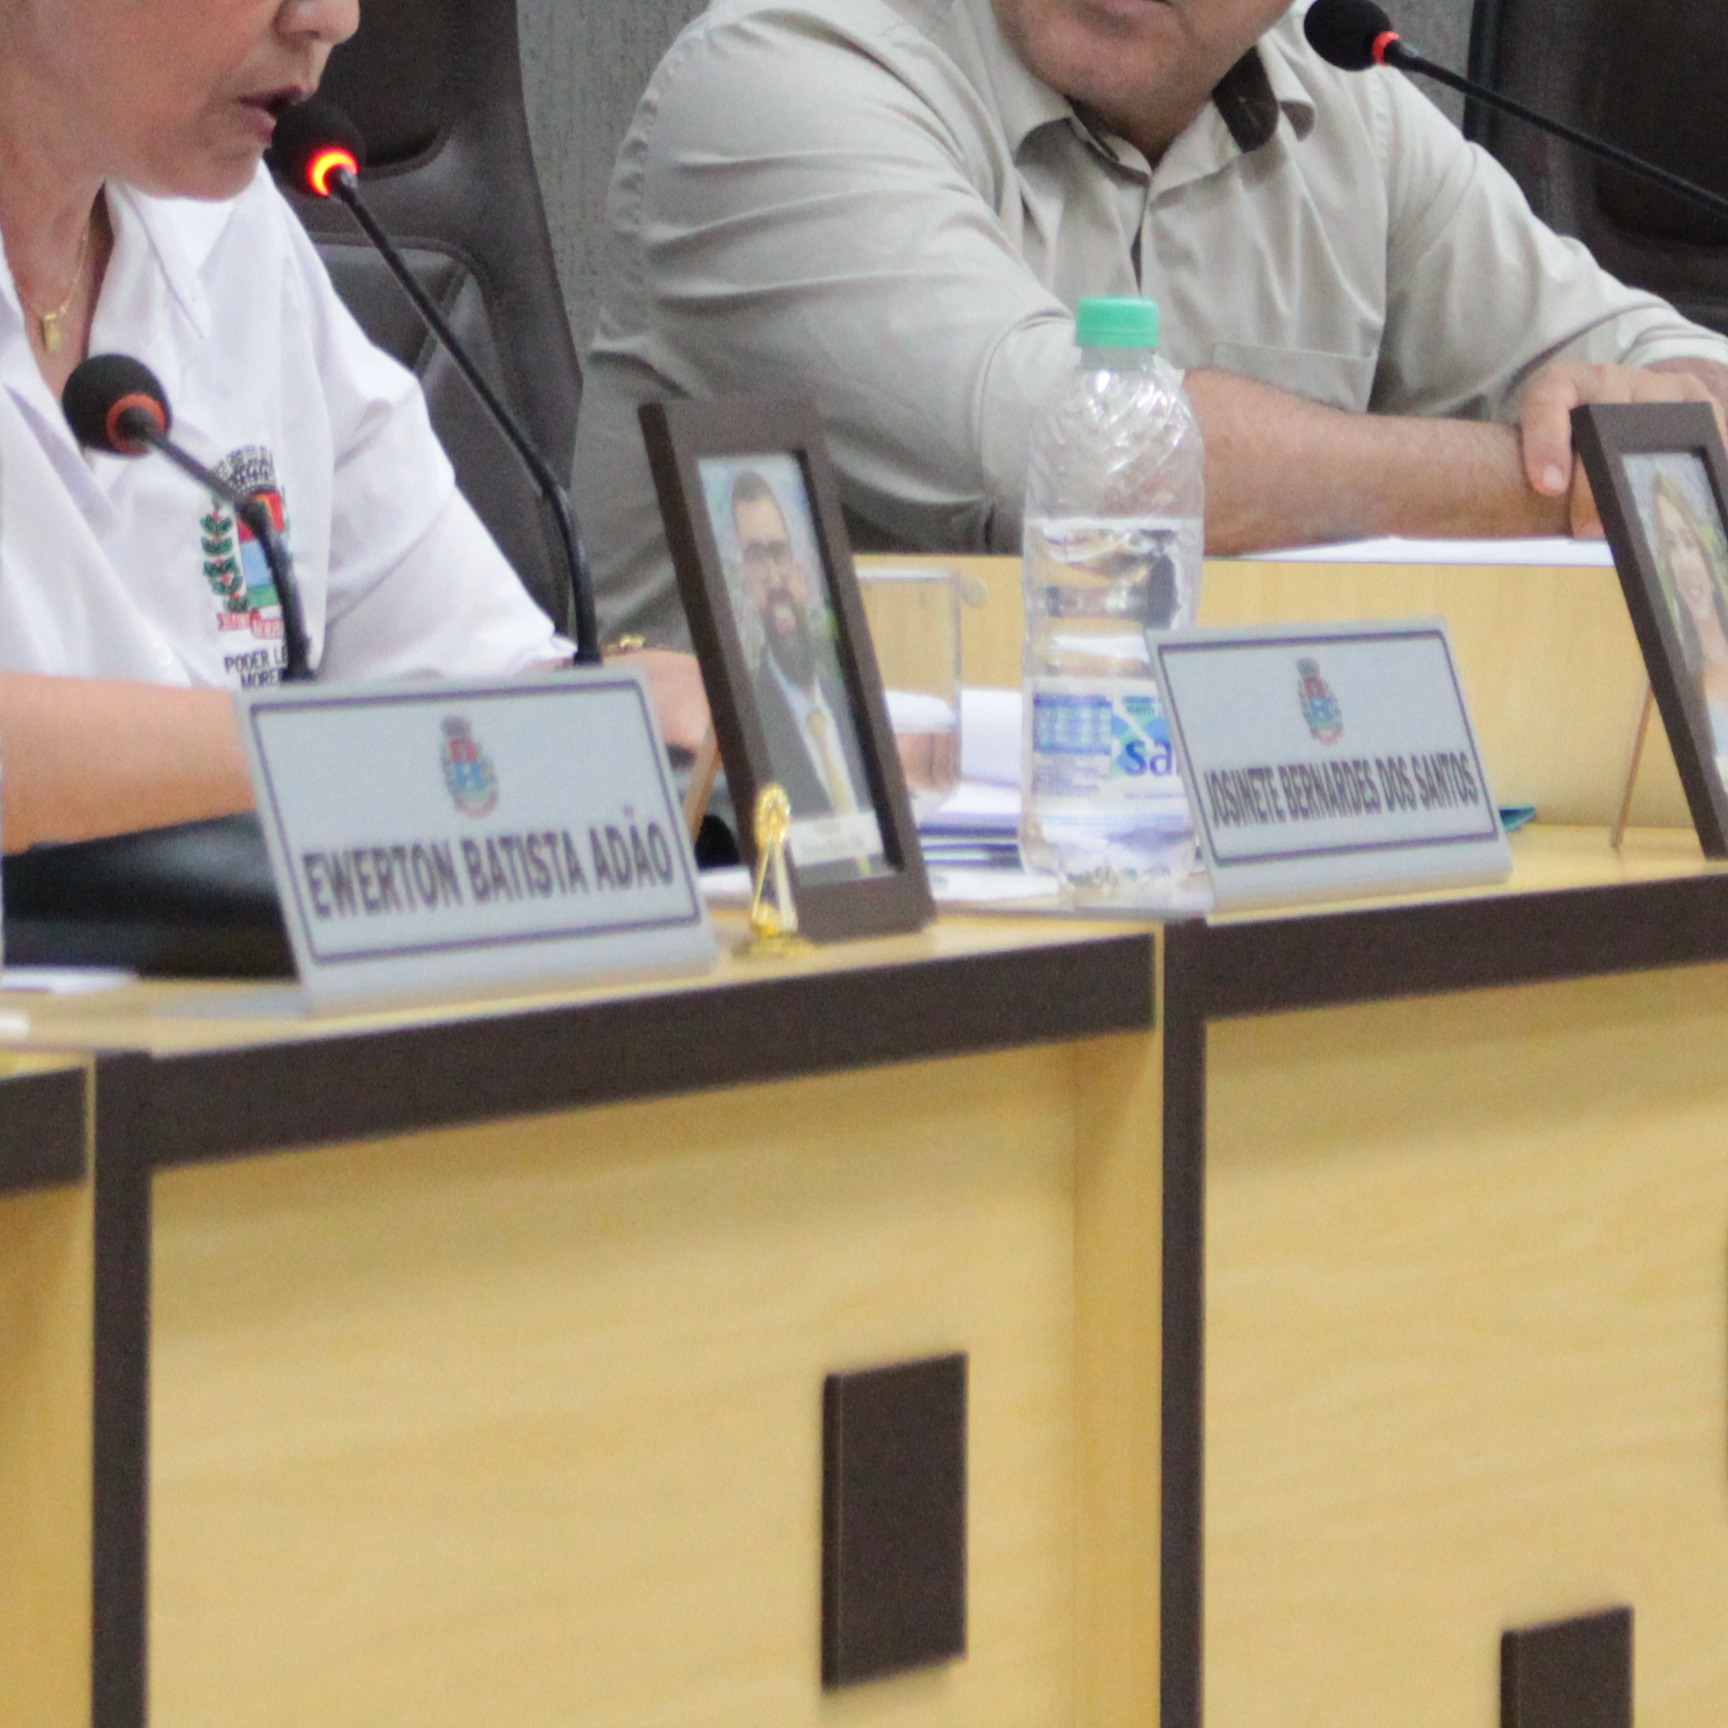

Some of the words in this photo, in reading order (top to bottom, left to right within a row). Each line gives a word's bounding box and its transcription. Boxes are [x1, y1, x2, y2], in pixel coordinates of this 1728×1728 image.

[224, 649, 270, 674] PODER
[1278, 759, 1382, 821] BERNARDES
[1375, 755, 1418, 812] DOS
[1411, 751, 1479, 811] SANTOS
[303, 839, 464, 919] EWERTON
[460, 830, 590, 905] BATISTA
[588, 803, 674, 891] ADÃO
